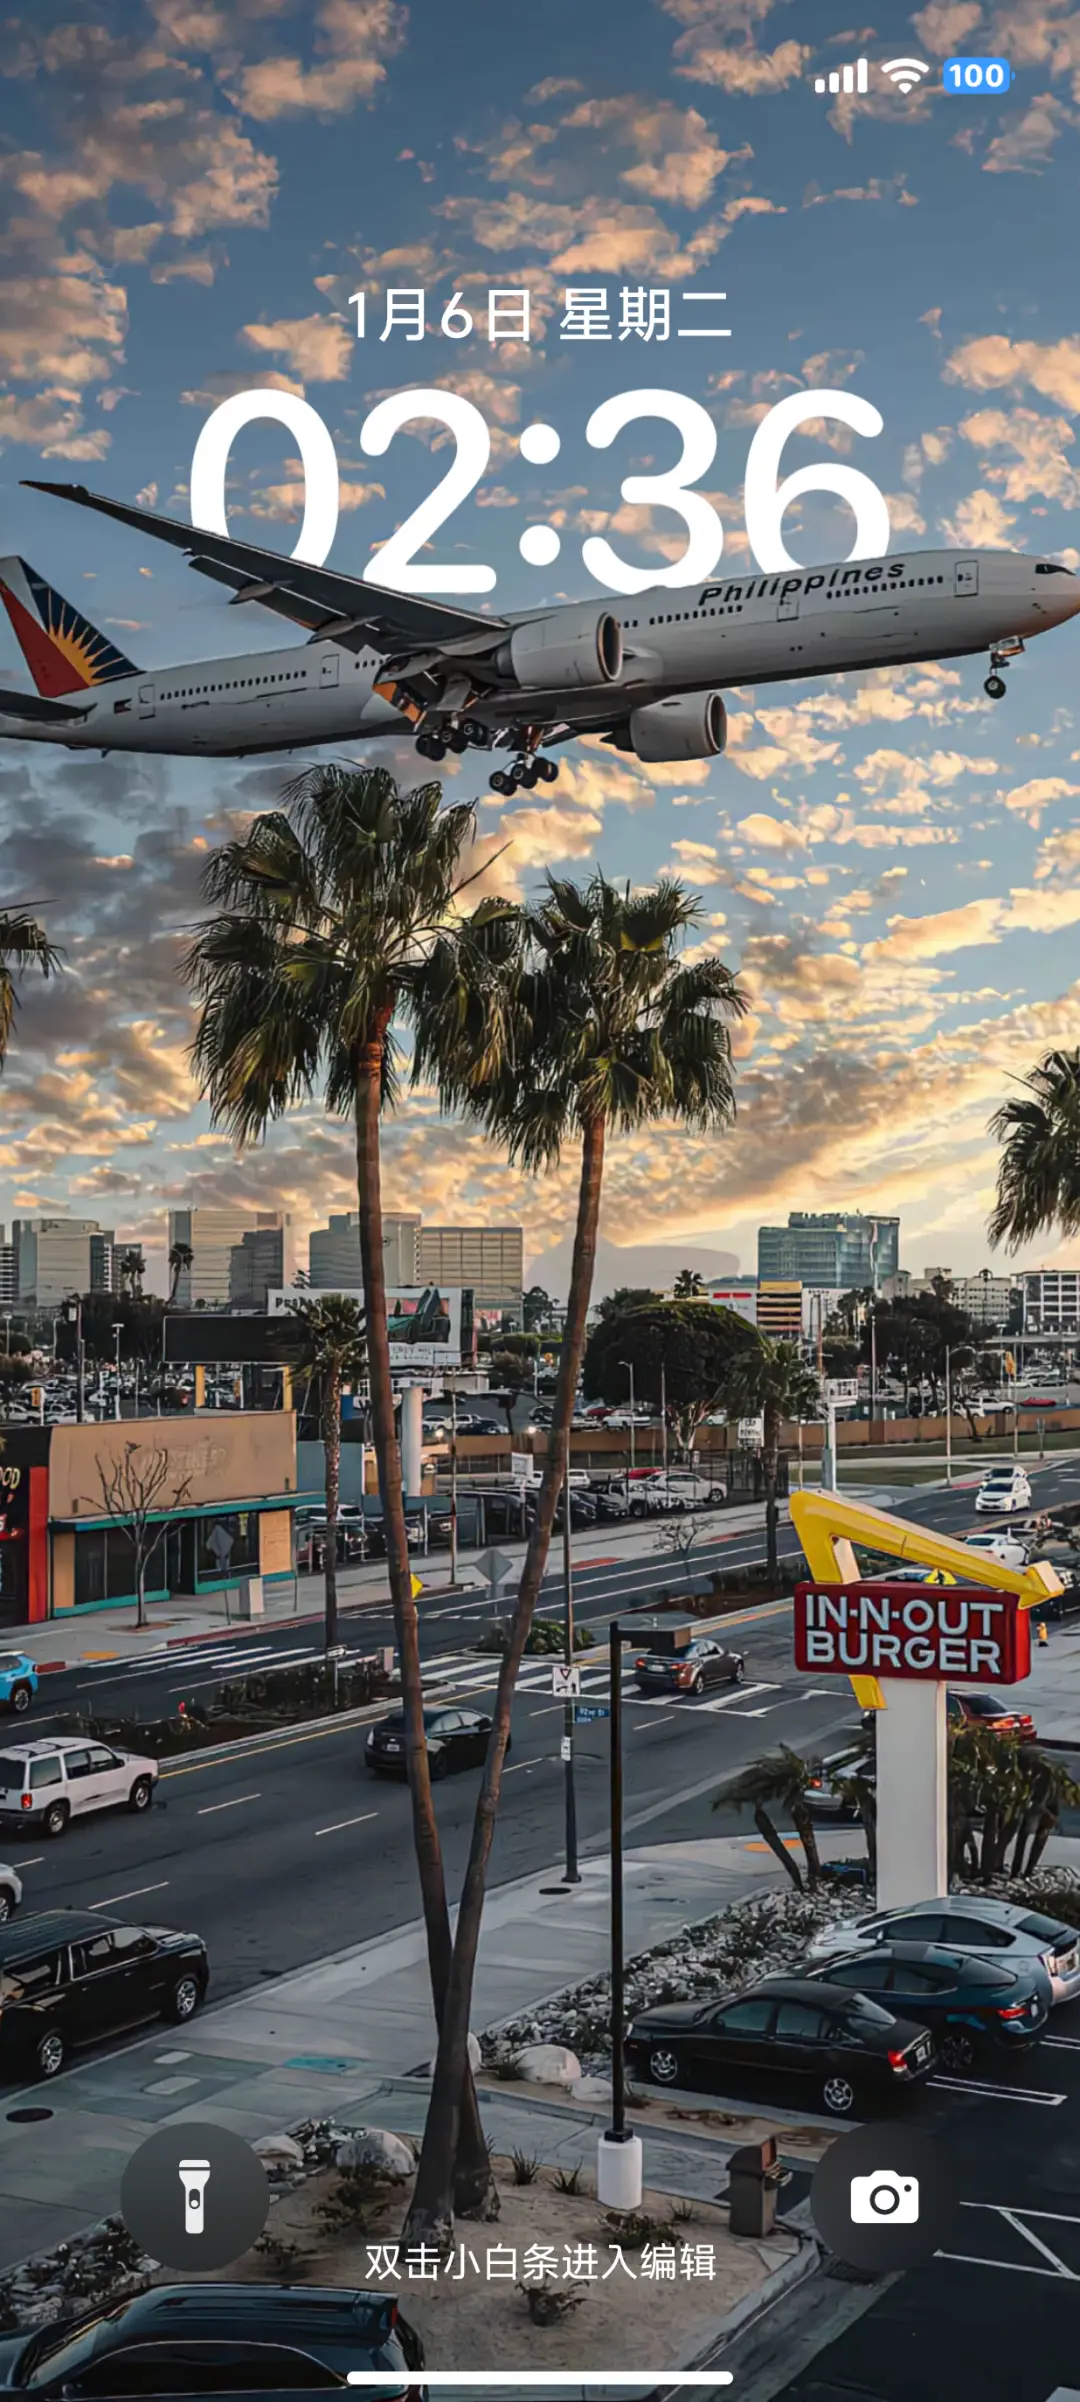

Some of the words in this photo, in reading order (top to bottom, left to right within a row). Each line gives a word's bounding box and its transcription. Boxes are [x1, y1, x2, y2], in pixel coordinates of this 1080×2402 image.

[698, 562, 906, 607] Philippines
[806, 1594, 1004, 1637] IN-N-OUT
[806, 1630, 1001, 1675] BURGER
